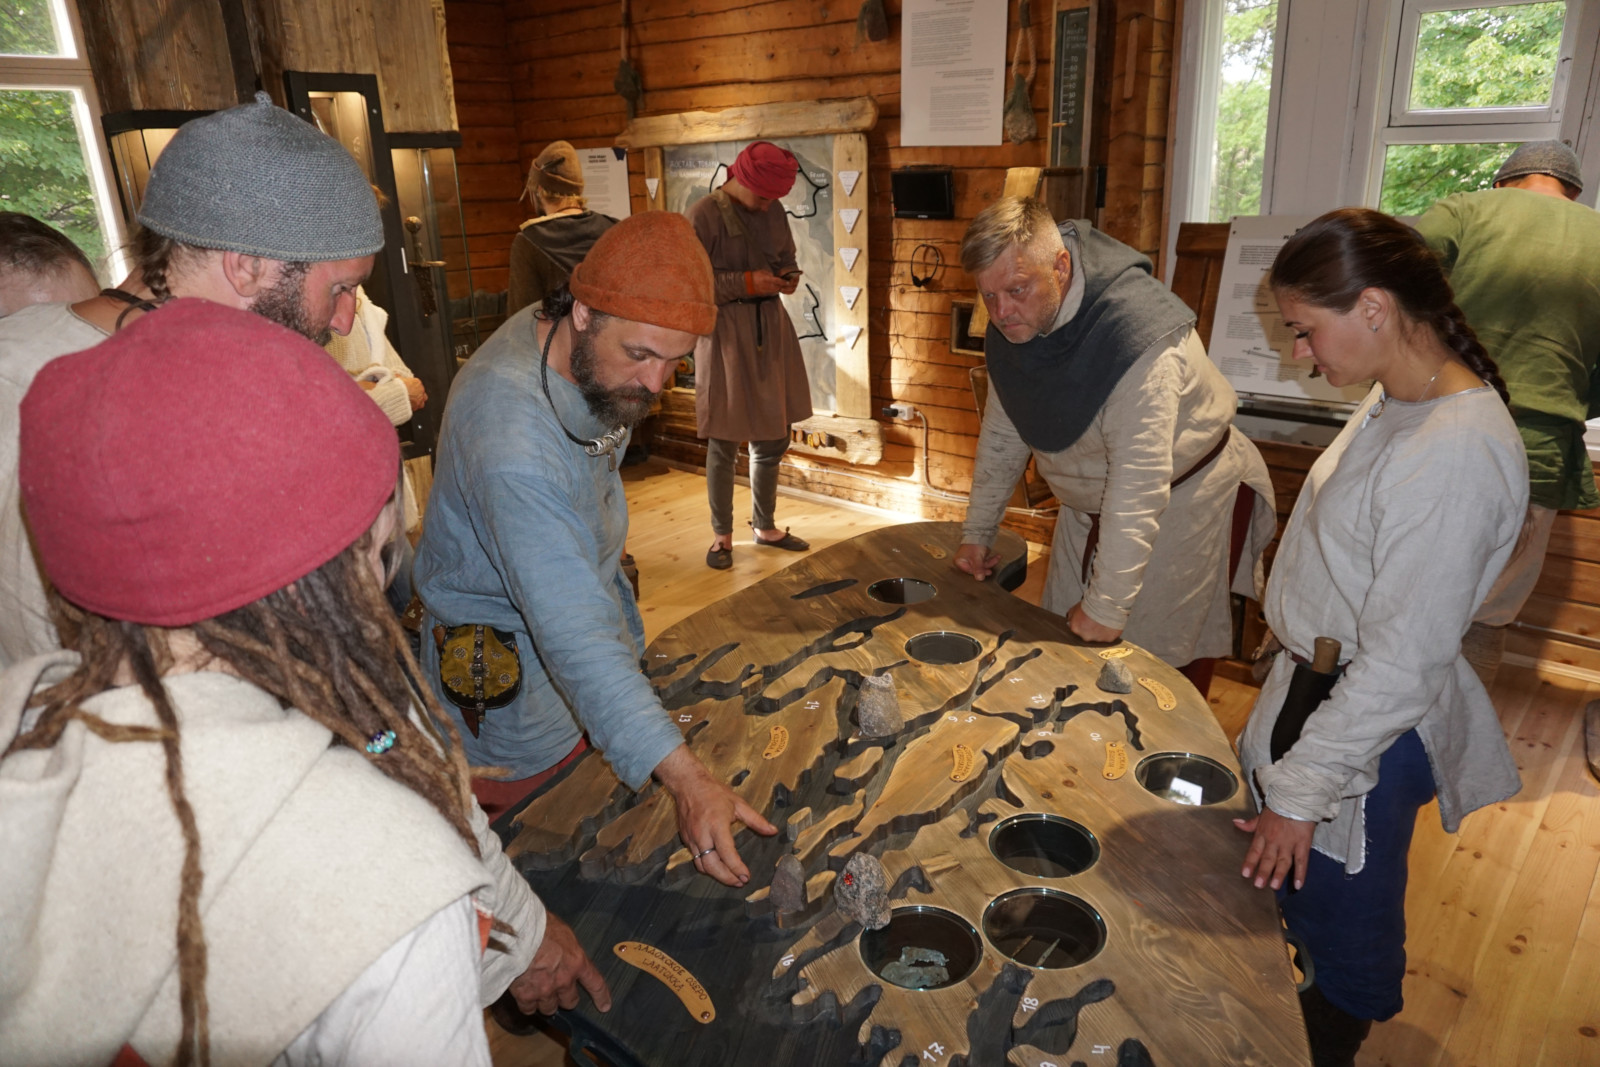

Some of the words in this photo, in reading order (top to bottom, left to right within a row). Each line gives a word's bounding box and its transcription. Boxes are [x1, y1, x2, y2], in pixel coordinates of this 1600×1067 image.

[678, 714, 693, 723] 13
[780, 954, 795, 966] 16
[641, 958, 685, 992] LAATOKKA
[685, 976, 708, 1001] ОЗЕРО
[1021, 997, 1039, 1013] 18
[922, 1041, 945, 1063] 17
